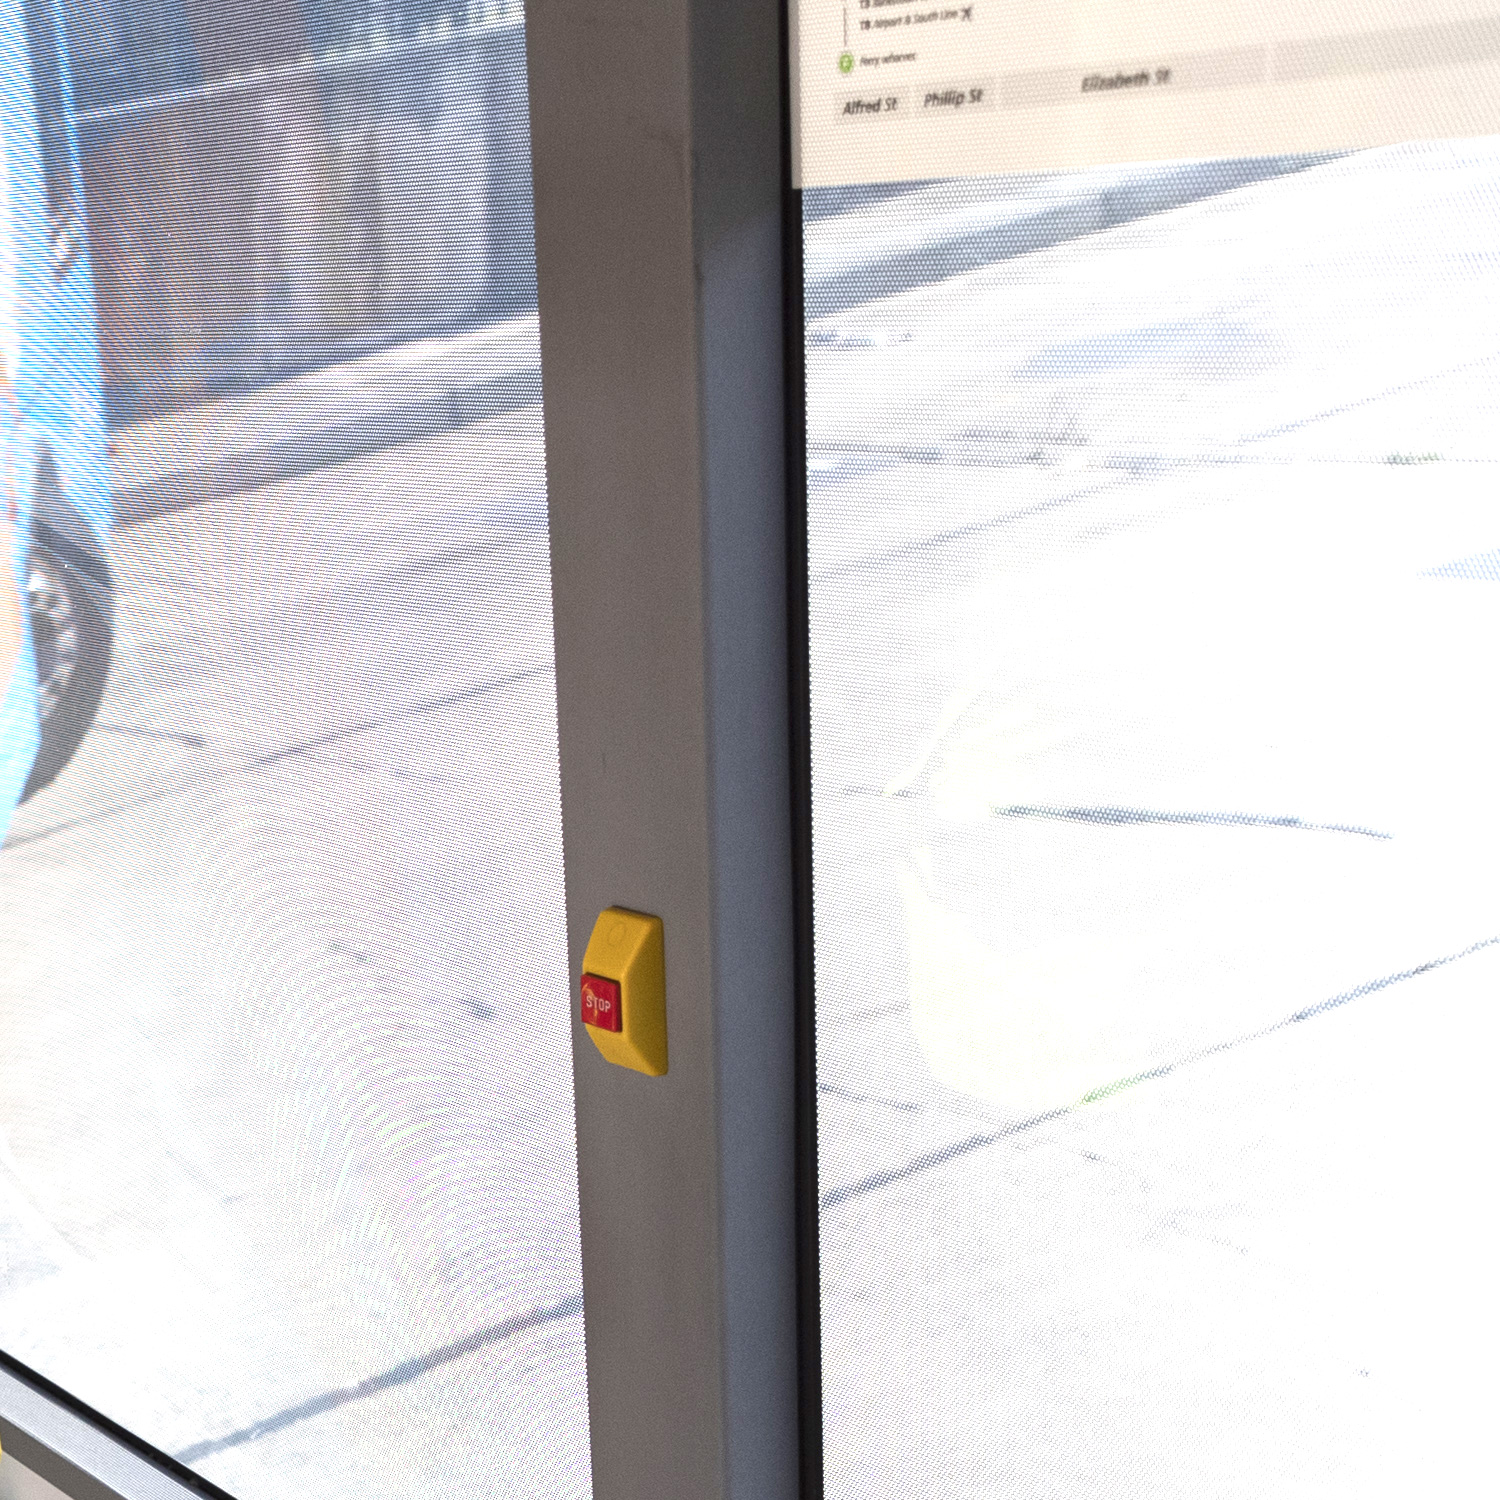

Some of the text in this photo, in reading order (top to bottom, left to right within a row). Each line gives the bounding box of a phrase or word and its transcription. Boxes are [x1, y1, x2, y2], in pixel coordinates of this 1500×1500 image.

[1081, 72, 1149, 92] Elizabeth
[842, 97, 898, 116] Alfred St
[924, 88, 984, 108] Phillip St
[586, 995, 611, 1013] STOP
